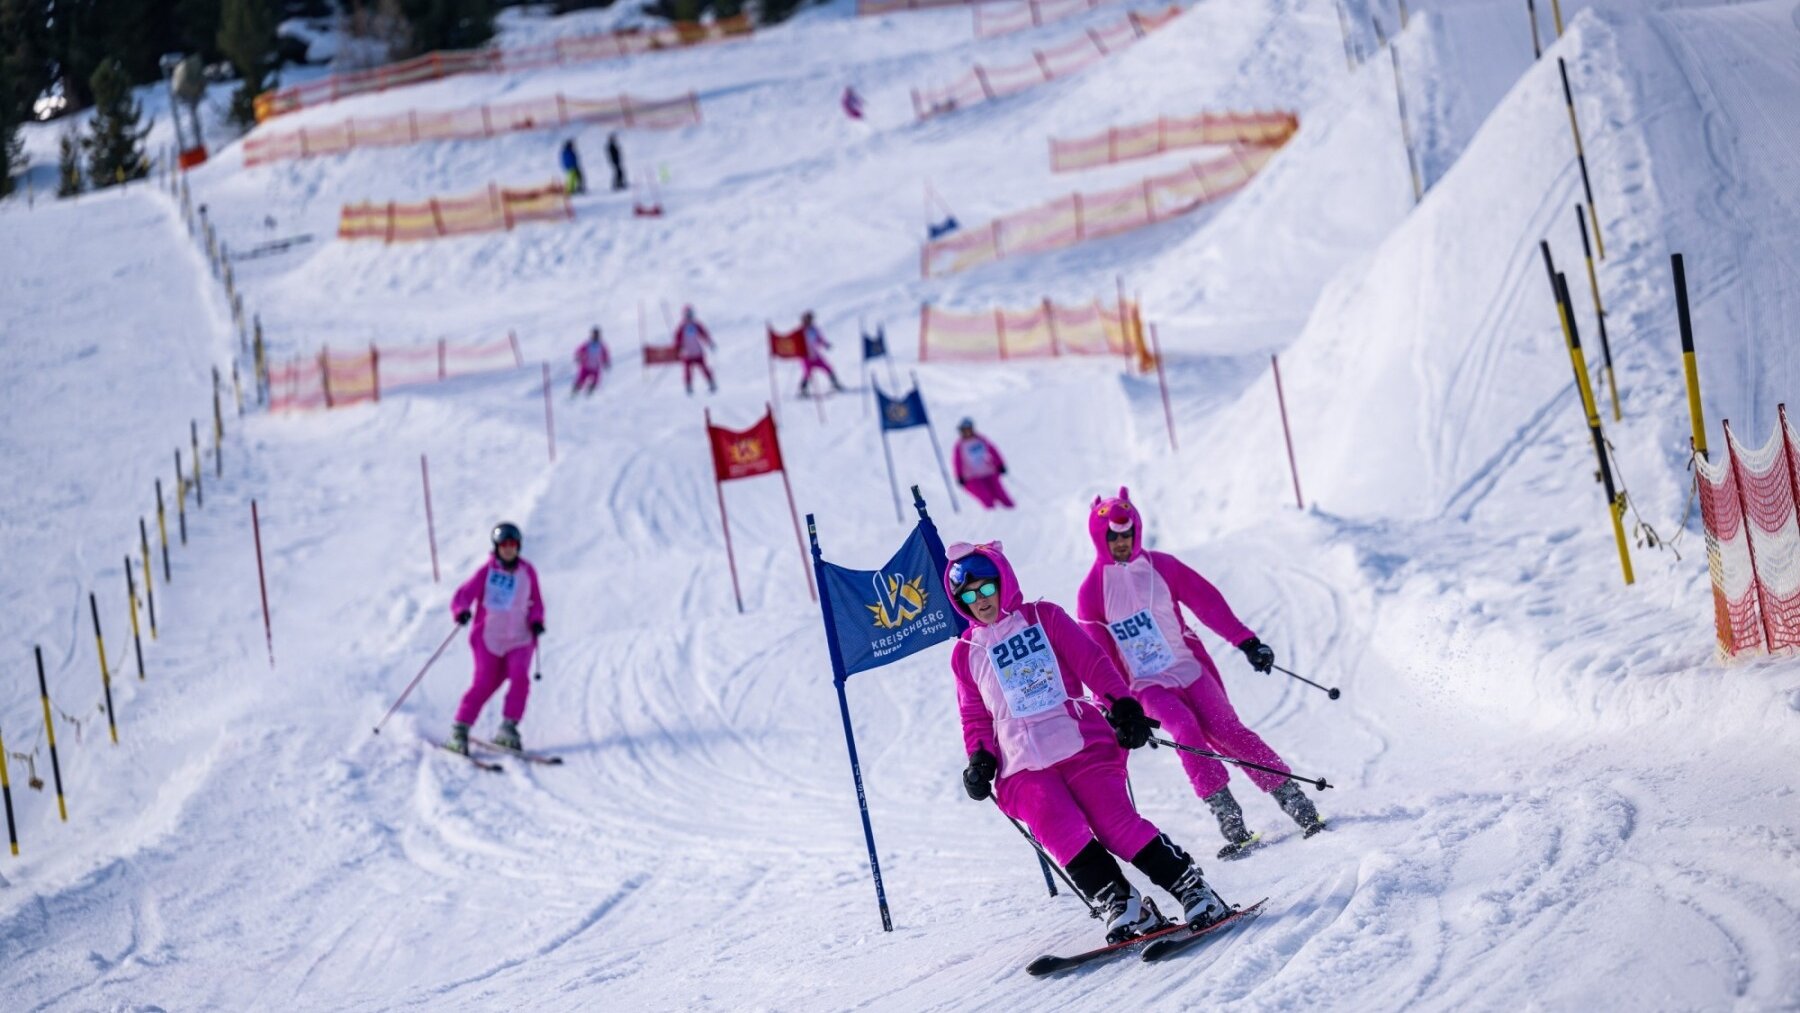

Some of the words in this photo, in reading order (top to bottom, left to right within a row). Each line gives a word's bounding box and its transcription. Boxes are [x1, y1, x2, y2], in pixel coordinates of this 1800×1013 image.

[871, 610, 945, 650] KREISCHBERG
[921, 621, 948, 636] Styria
[1110, 611, 1153, 641] 564
[873, 643, 902, 658] Murau
[992, 626, 1046, 669] 282
